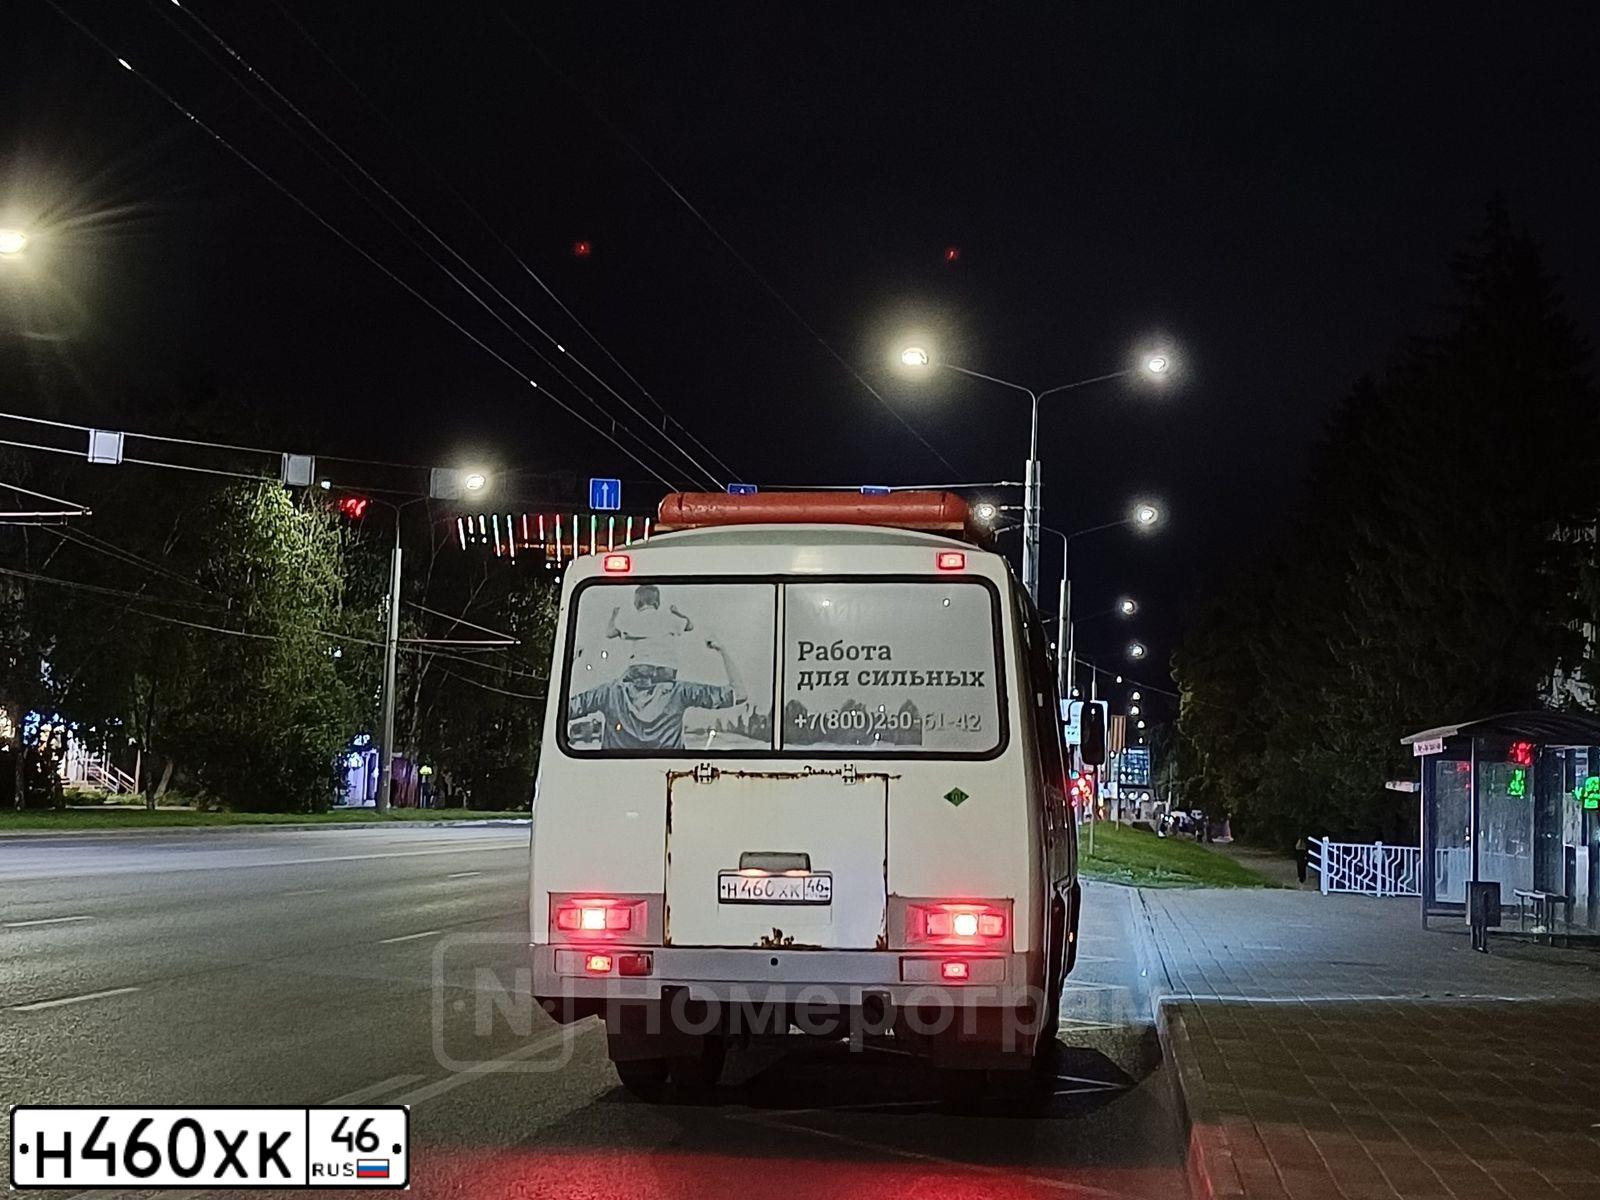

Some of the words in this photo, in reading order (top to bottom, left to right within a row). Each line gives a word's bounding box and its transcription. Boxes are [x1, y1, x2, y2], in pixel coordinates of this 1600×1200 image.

[797, 639, 892, 661] Работа
[797, 670, 850, 690] для
[857, 669, 986, 688] сильных
